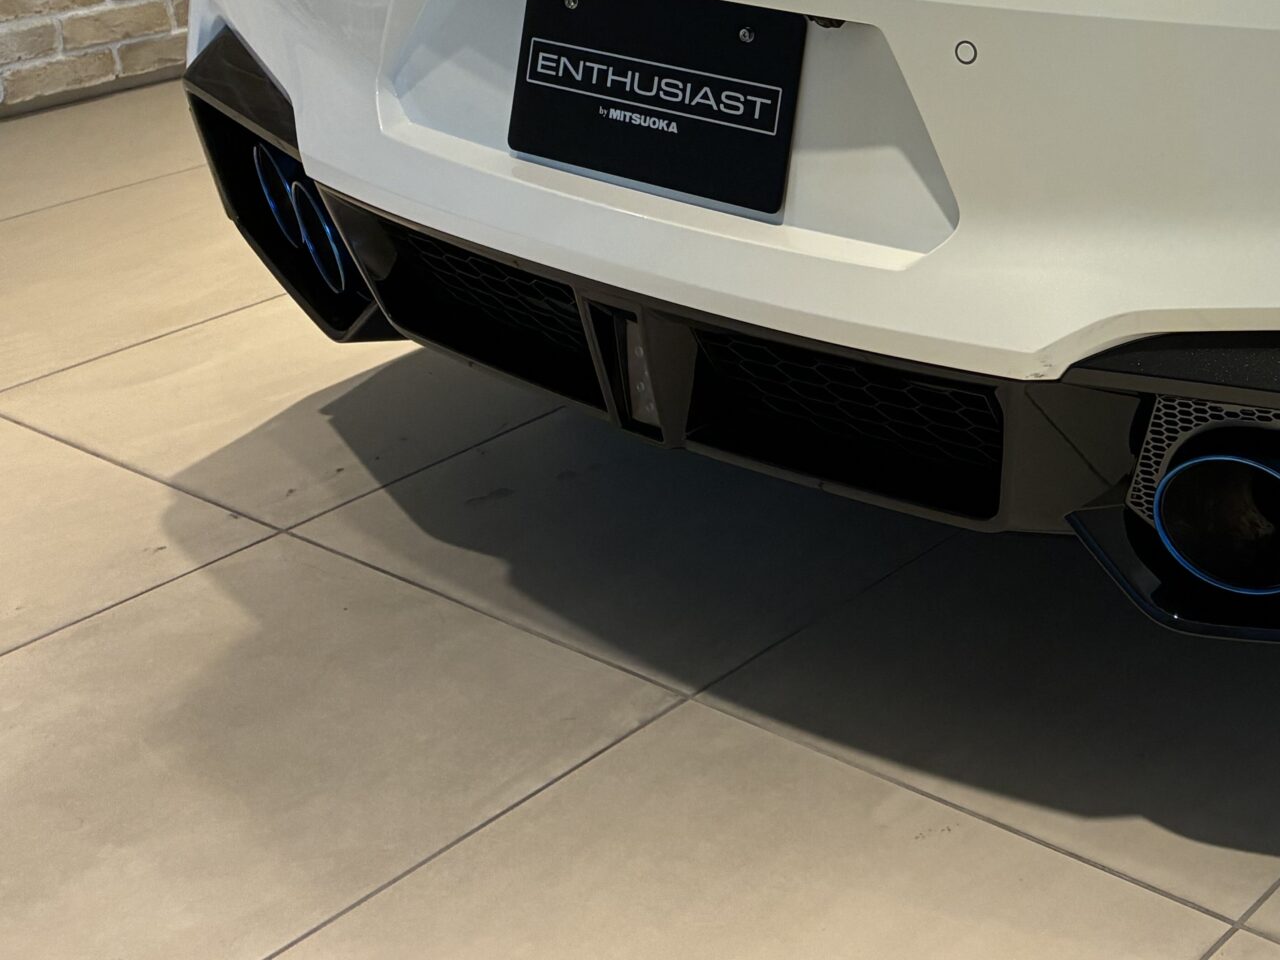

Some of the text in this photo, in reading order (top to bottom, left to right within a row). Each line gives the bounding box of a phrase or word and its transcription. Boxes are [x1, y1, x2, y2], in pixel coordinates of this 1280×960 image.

[536, 51, 772, 120] ENTHUSIAST
[598, 105, 679, 134] by MITSUOKA
